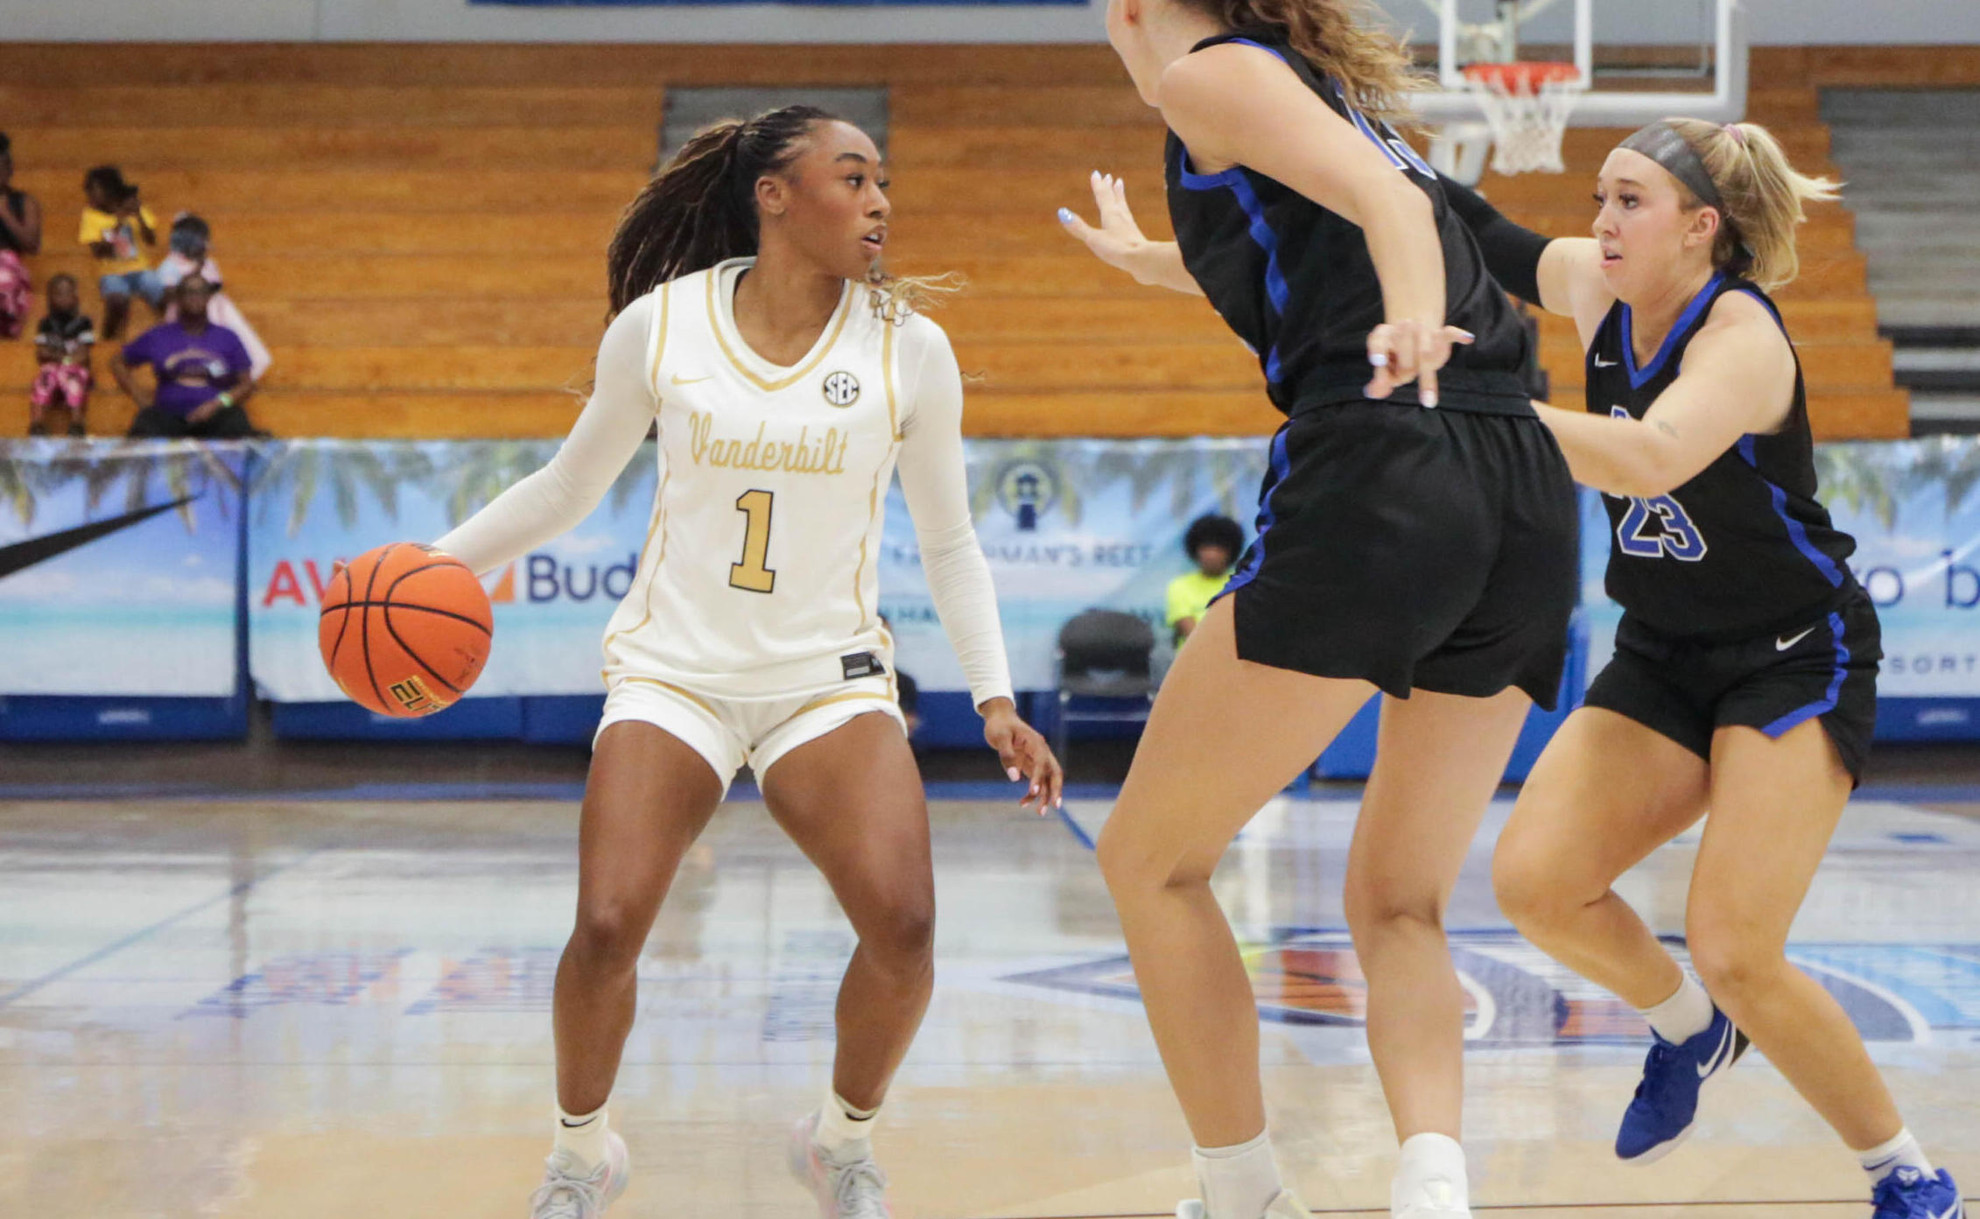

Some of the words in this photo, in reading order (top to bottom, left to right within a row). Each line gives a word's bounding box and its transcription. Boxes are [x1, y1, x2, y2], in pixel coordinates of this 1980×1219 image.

[825, 372, 859, 406] SEC
[689, 411, 848, 475] Vanderbilt
[728, 488, 776, 594] 1
[1616, 492, 1708, 562] 23
[263, 558, 346, 607] AV
[526, 553, 637, 605] Bud
[1888, 656, 1976, 675] SORT
